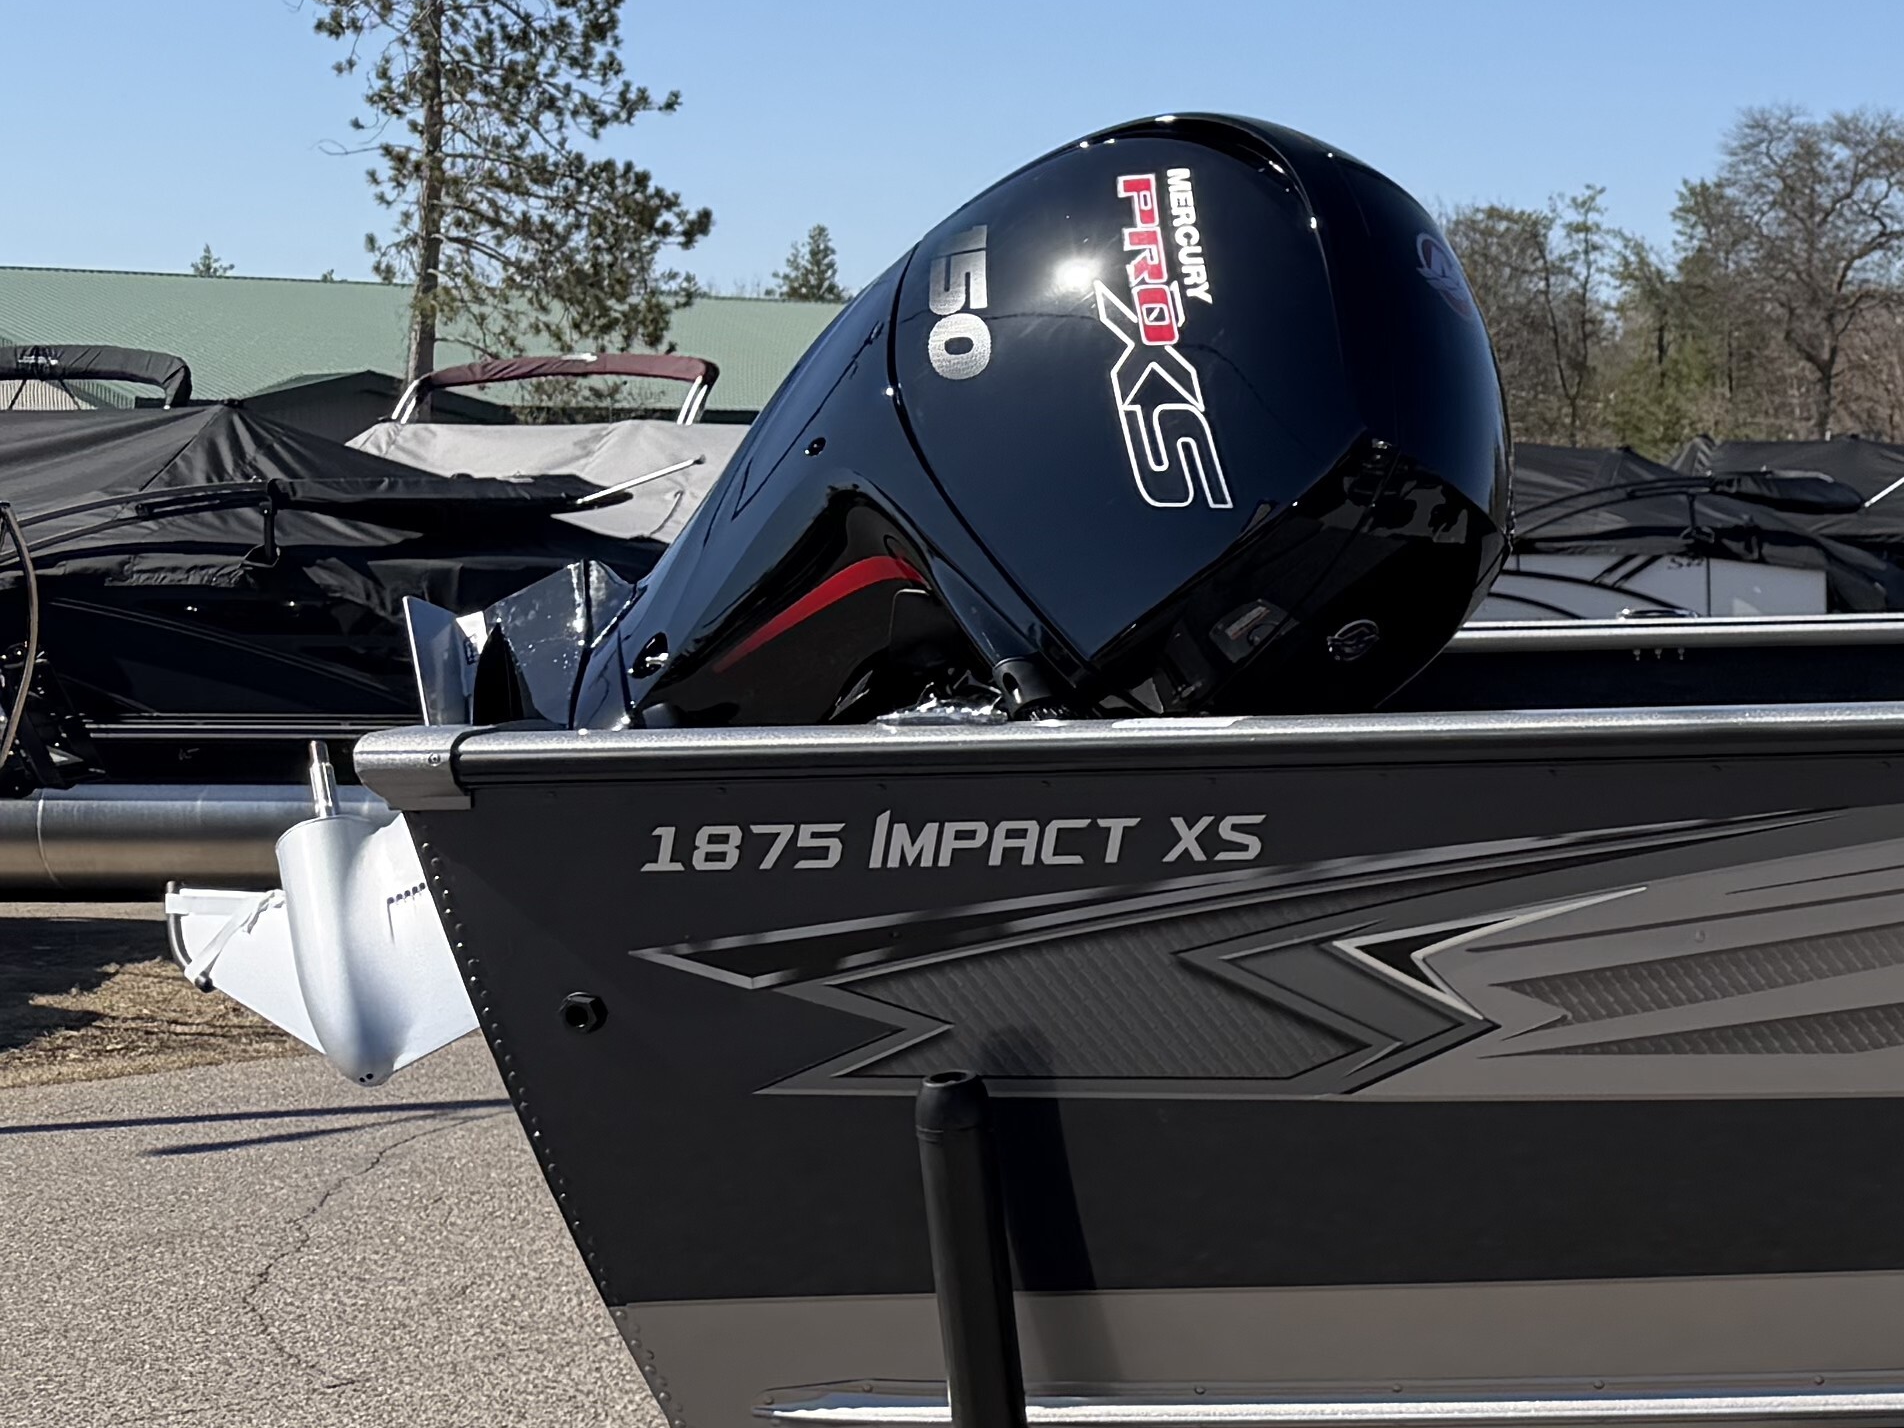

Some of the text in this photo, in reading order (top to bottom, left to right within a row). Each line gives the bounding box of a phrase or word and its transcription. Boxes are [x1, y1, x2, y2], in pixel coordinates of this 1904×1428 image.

[928, 224, 992, 380] 150
[1166, 168, 1213, 305] MERCURY
[1094, 173, 1233, 510] PRO XS
[641, 809, 1267, 872] 1875 IMPACT XS
